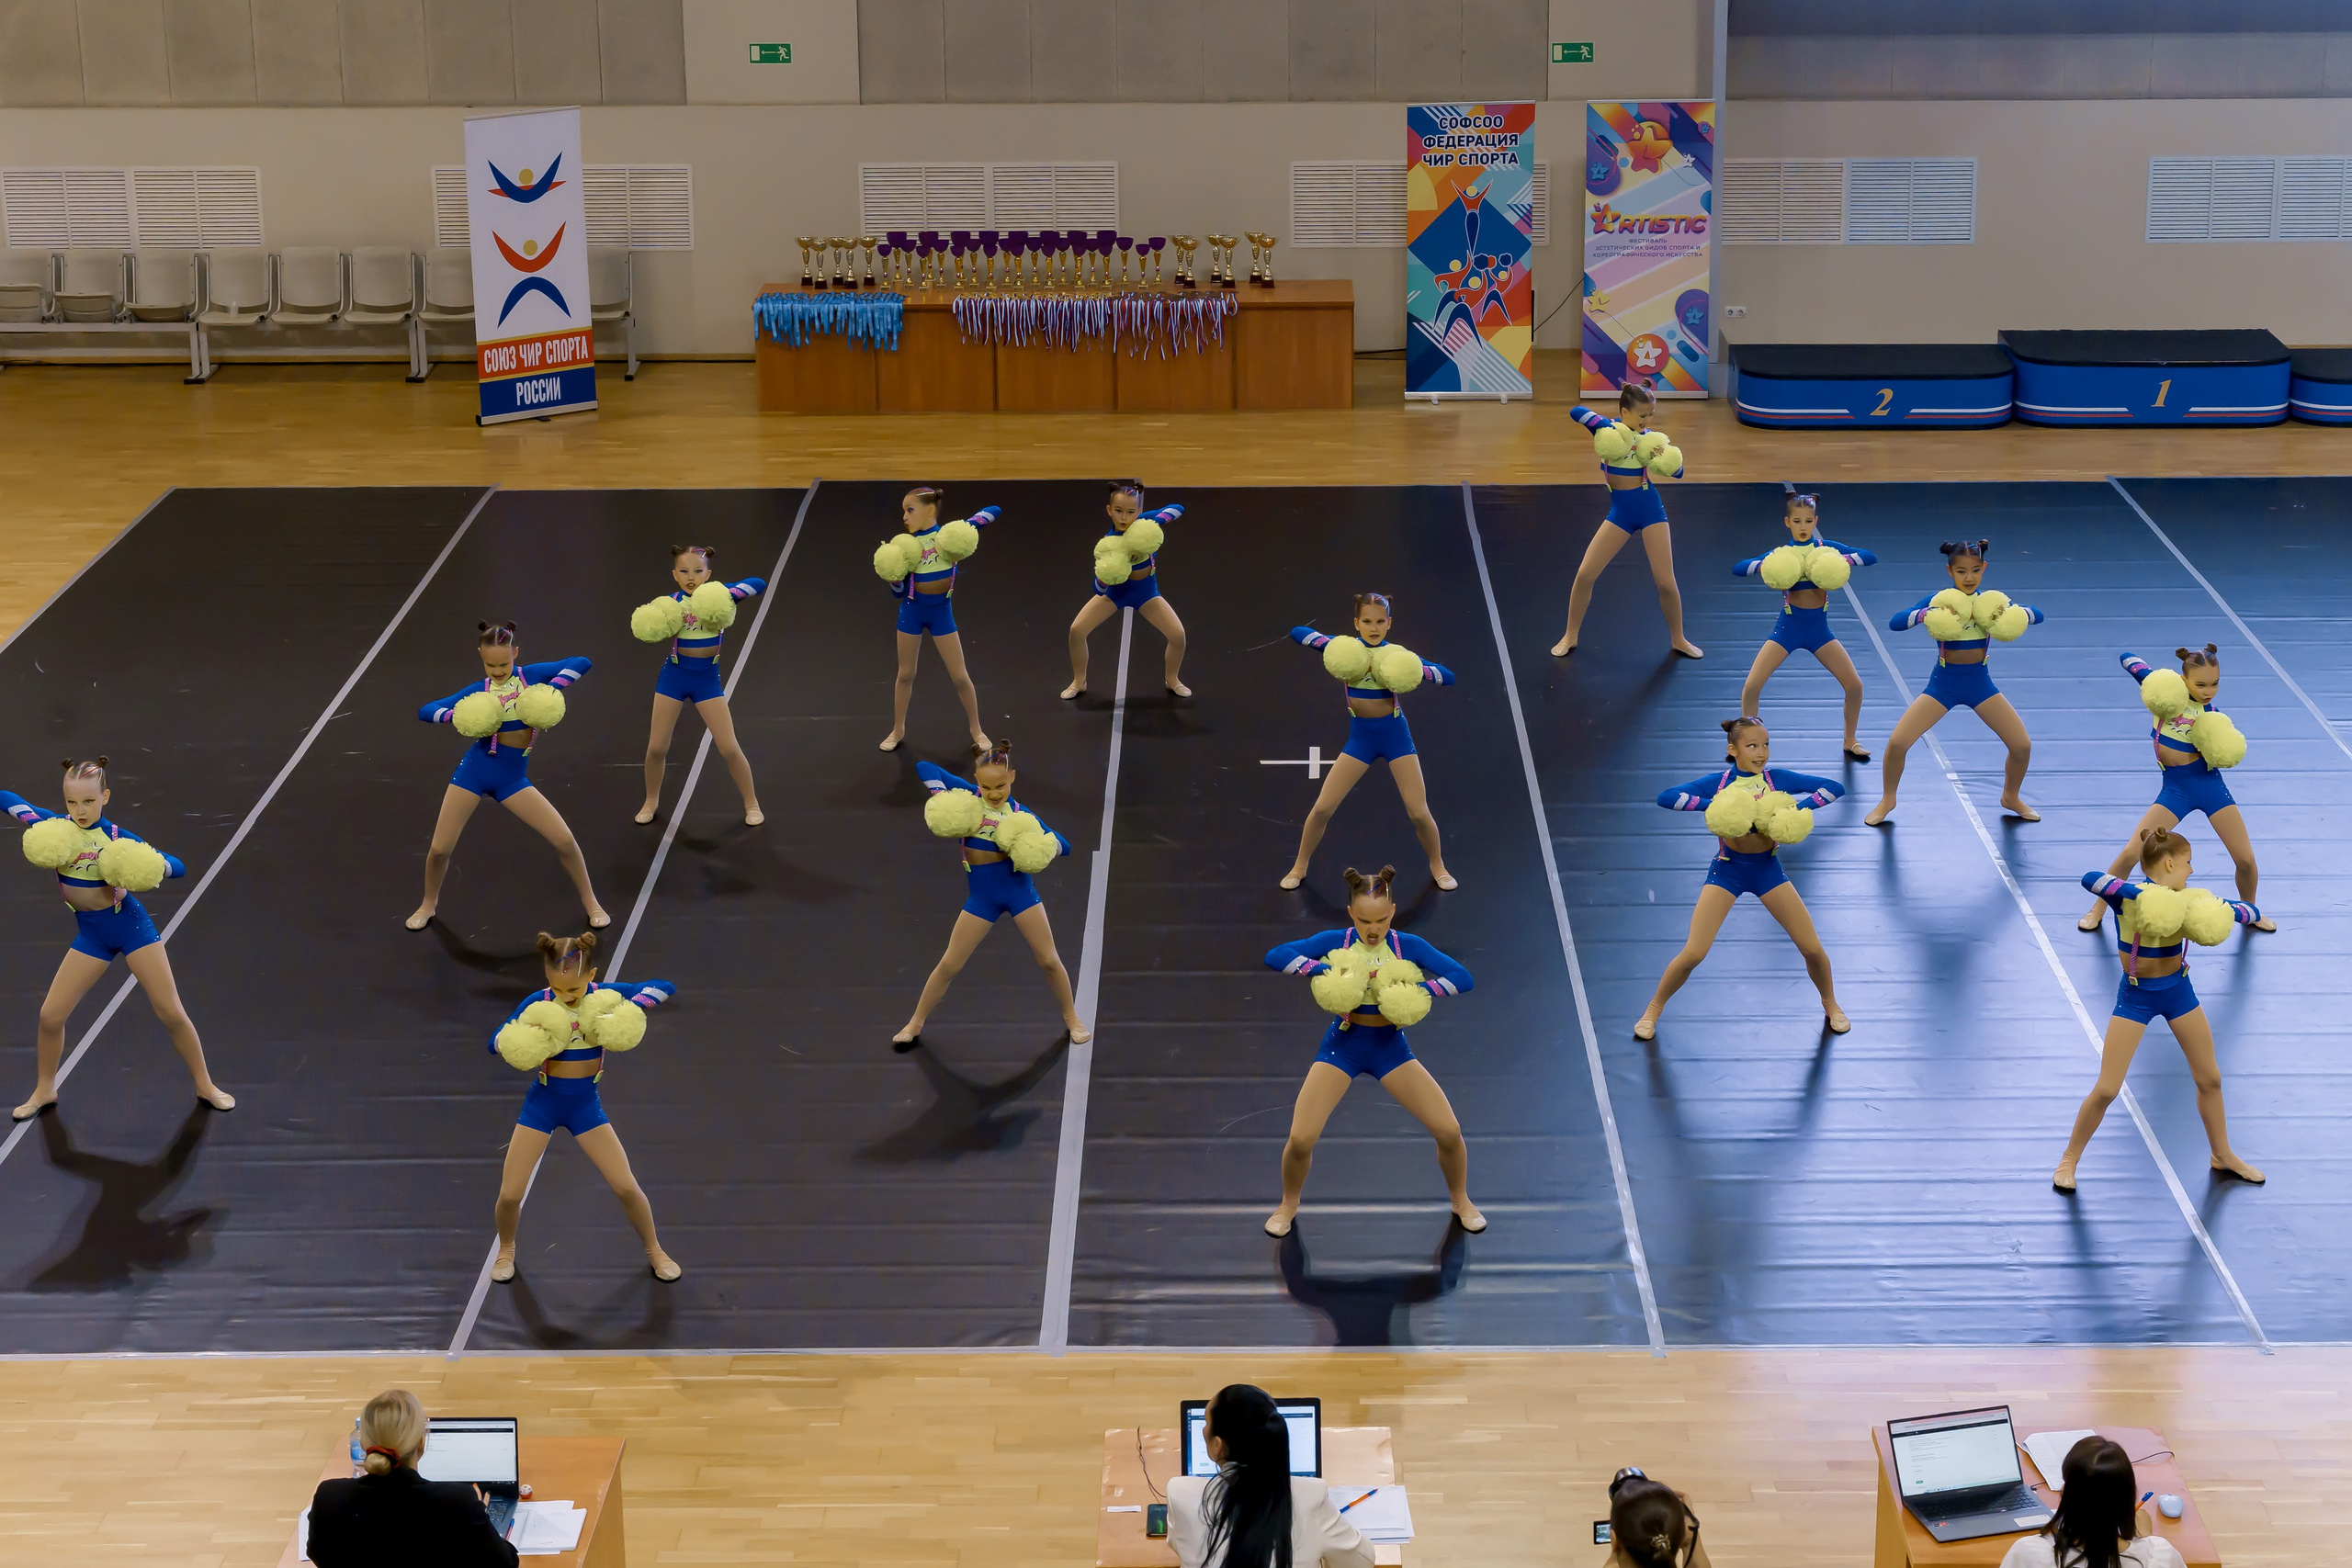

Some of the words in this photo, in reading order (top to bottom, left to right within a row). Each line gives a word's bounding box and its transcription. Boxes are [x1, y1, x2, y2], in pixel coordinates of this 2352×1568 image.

[1439, 116, 1503, 129] СОФСОО
[1423, 134, 1519, 150] ФЕДЕРАЦИЯ
[1422, 153, 1454, 166] ЧИР
[1458, 152, 1519, 165] СПОРТА
[1590, 204, 1707, 234] ARTISTIC
[483, 346, 517, 374] СОЮЗ
[519, 342, 543, 367] ЧИР
[545, 335, 589, 365] СПОРТА
[515, 377, 561, 406] РОССИИ
[1869, 388, 1894, 416] 2
[2151, 379, 2172, 407] 1
